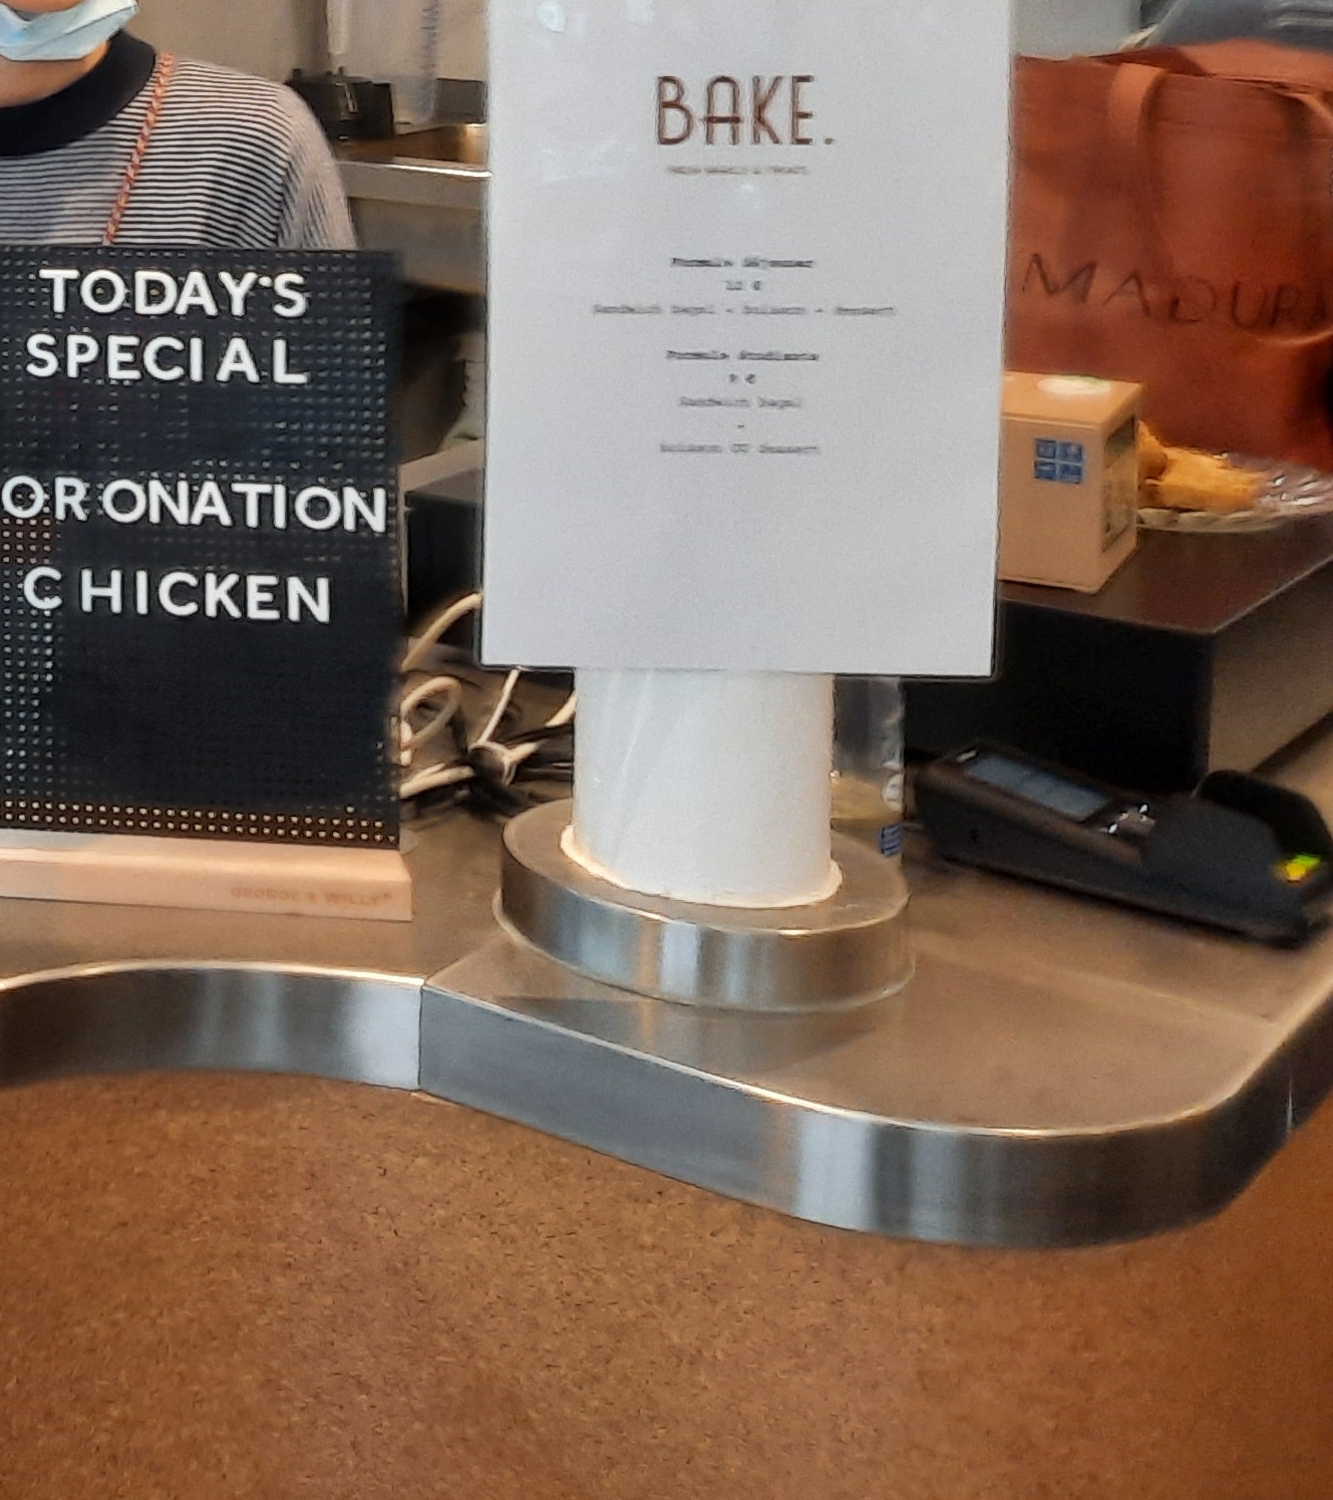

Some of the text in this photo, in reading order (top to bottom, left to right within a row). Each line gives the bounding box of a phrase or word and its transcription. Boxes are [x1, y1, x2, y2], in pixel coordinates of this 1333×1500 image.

[656, 75, 836, 146] BAKE.
[38, 268, 310, 319] TODAY'S
[25, 333, 309, 385] SPECIAL
[22, 564, 332, 624] CHICKEN
